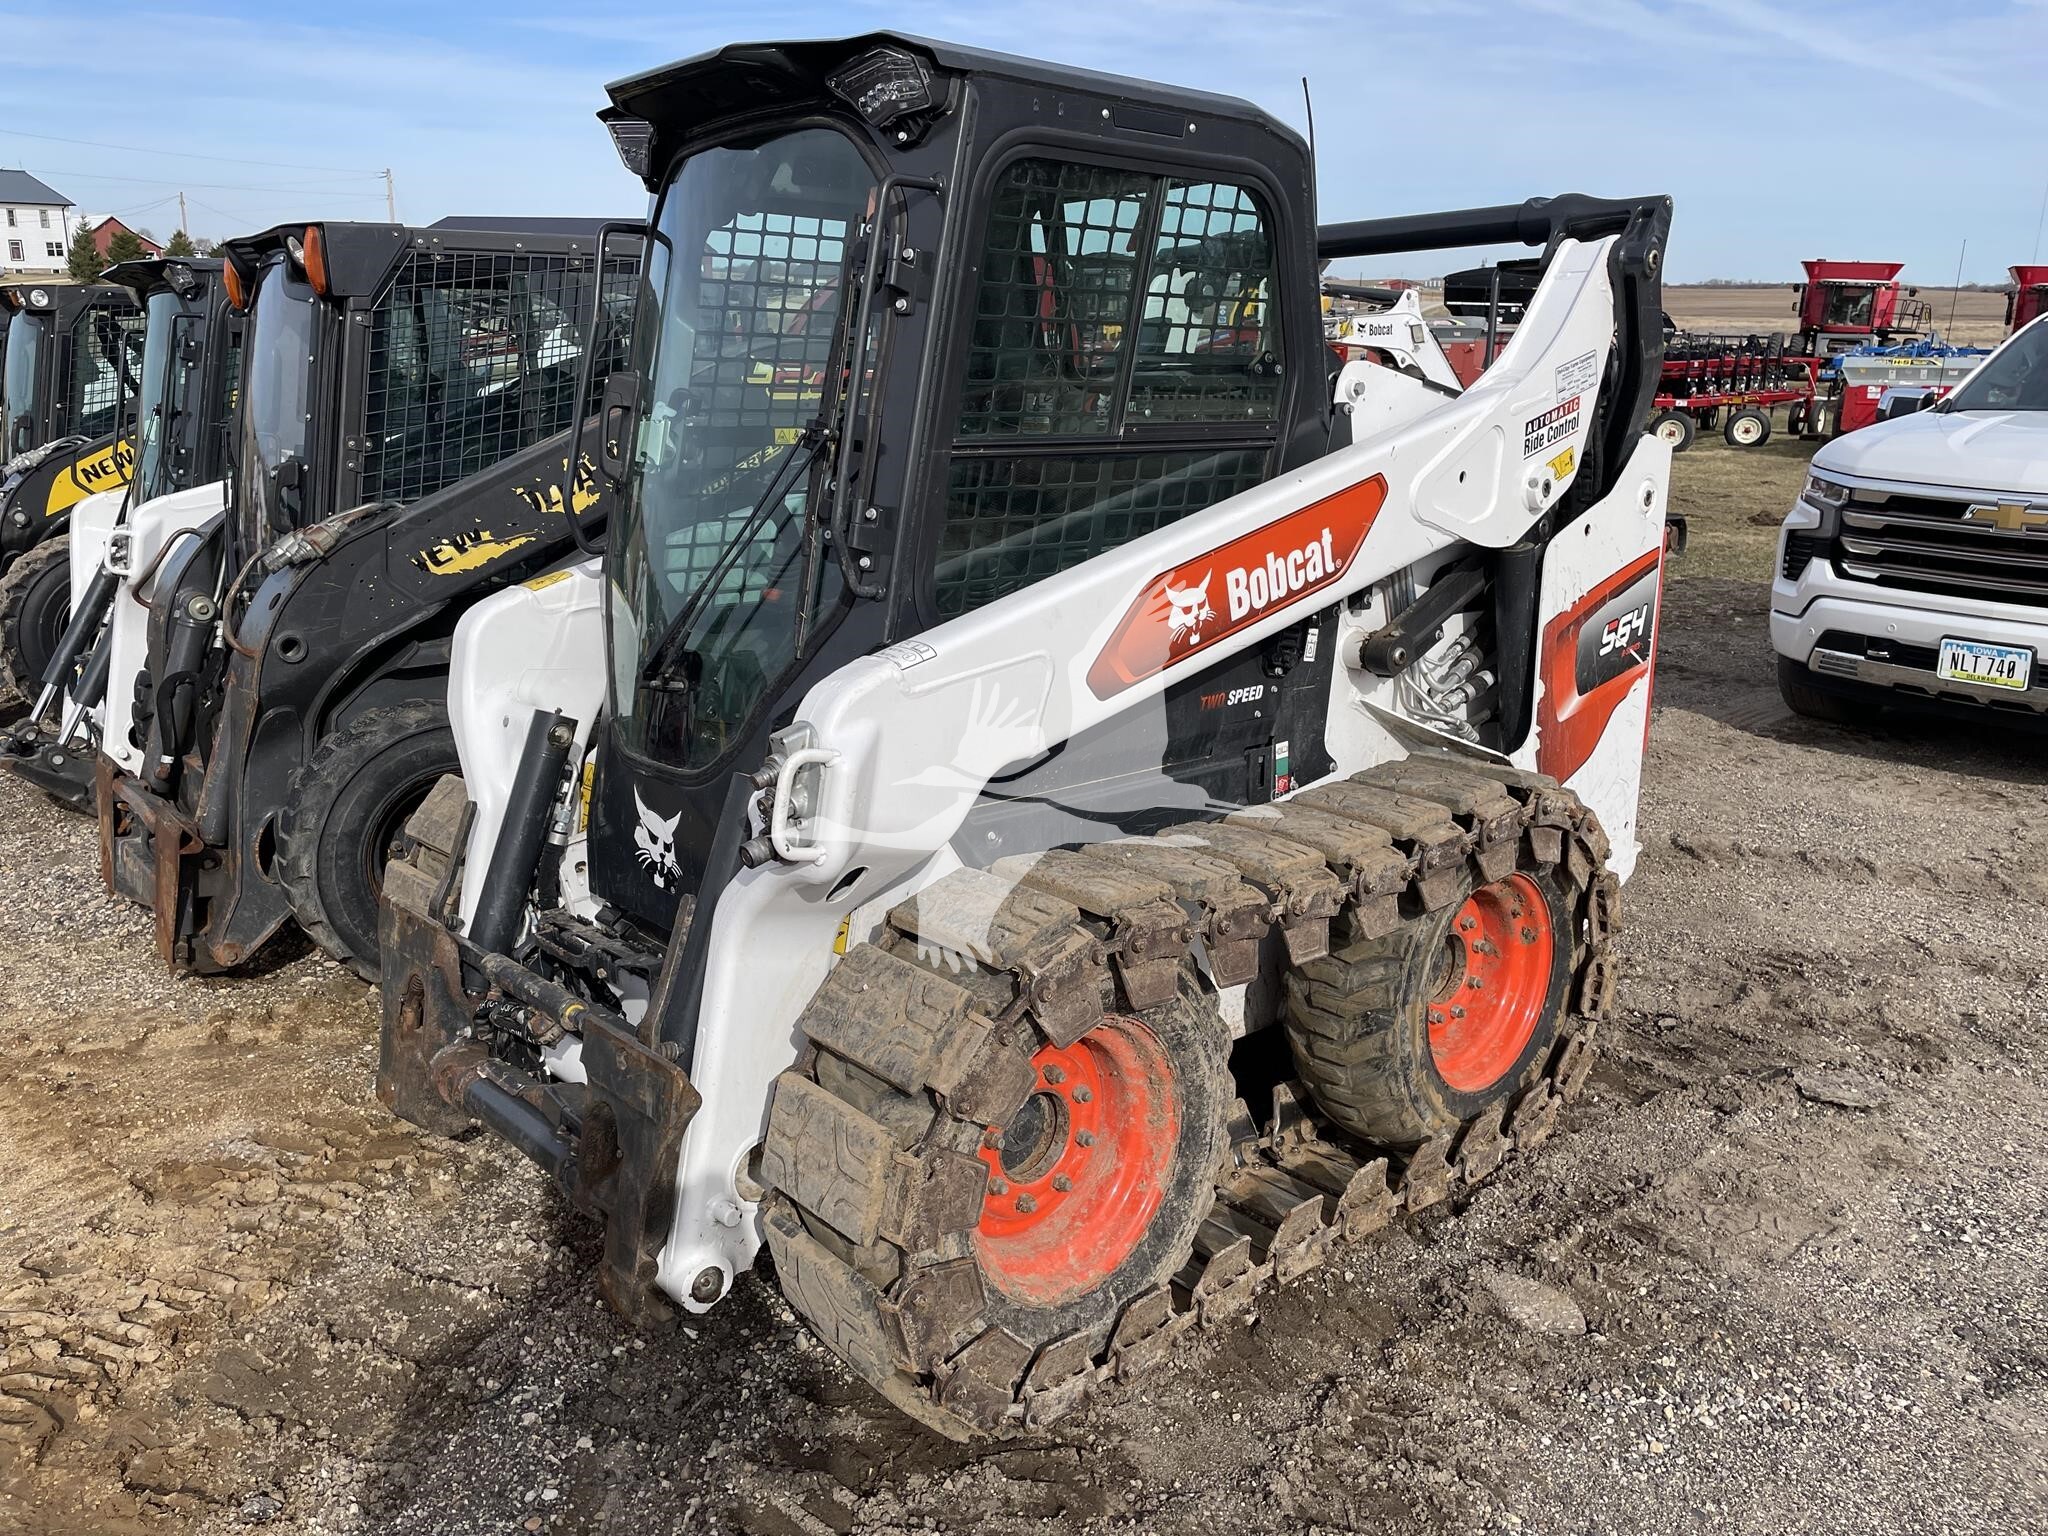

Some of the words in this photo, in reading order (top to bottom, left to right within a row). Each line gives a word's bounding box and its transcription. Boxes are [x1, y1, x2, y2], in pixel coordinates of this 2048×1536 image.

[1368, 323, 1393, 336] Bobcat
[1526, 399, 1579, 436] AUTOMATIC
[1523, 432, 1545, 456] Ride
[1547, 411, 1580, 442] Control
[80, 448, 133, 484] NEW
[1225, 527, 1335, 622] Bobcat
[1599, 603, 1648, 656] S64
[1949, 652, 1982, 674] NLT
[1986, 657, 2017, 679] 740
[1972, 646, 1998, 657] IOWA
[1966, 673, 1998, 683] DELAWARE
[1200, 692, 1226, 711] TWO
[1227, 684, 1264, 706] SPEED
